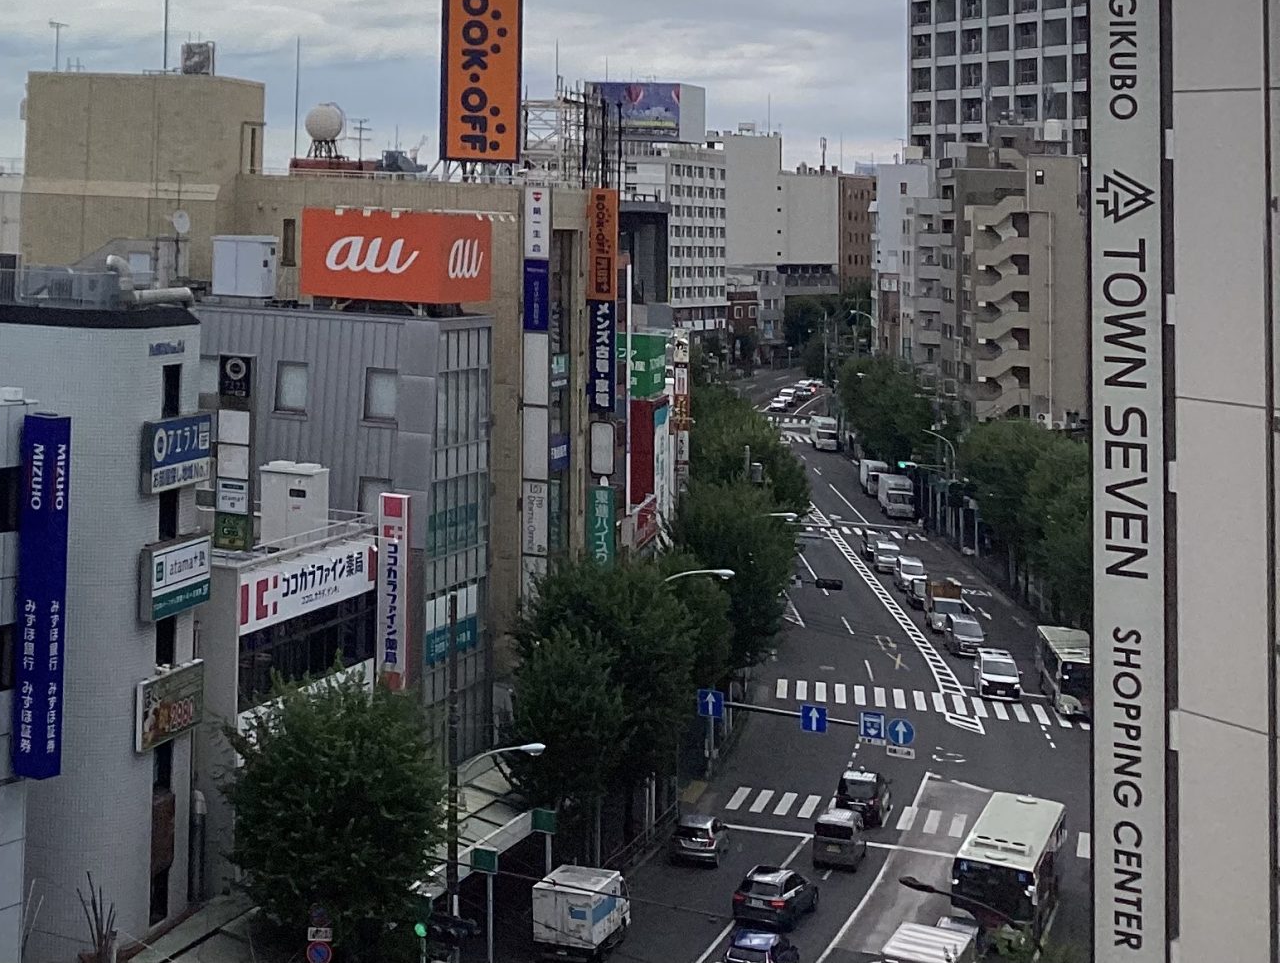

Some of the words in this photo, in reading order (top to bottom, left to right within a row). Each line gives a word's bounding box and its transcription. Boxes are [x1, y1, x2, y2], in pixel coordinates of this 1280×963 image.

[325, 235, 420, 275] au
[448, 238, 484, 279] au
[1103, 238, 1148, 389] TOWN
[31, 443, 45, 511] MIZUHO
[55, 443, 67, 511] MIZUHO
[1104, 405, 1149, 580] SEVEN
[282, 551, 363, 598] ココカラファイン薬局
[23, 599, 36, 671] みずほ銀行
[48, 600, 60, 671] みずほ銀行
[20, 681, 33, 754] みずほ証券
[1112, 626, 1143, 808] SHOPPING
[1113, 821, 1143, 950] CENTER
